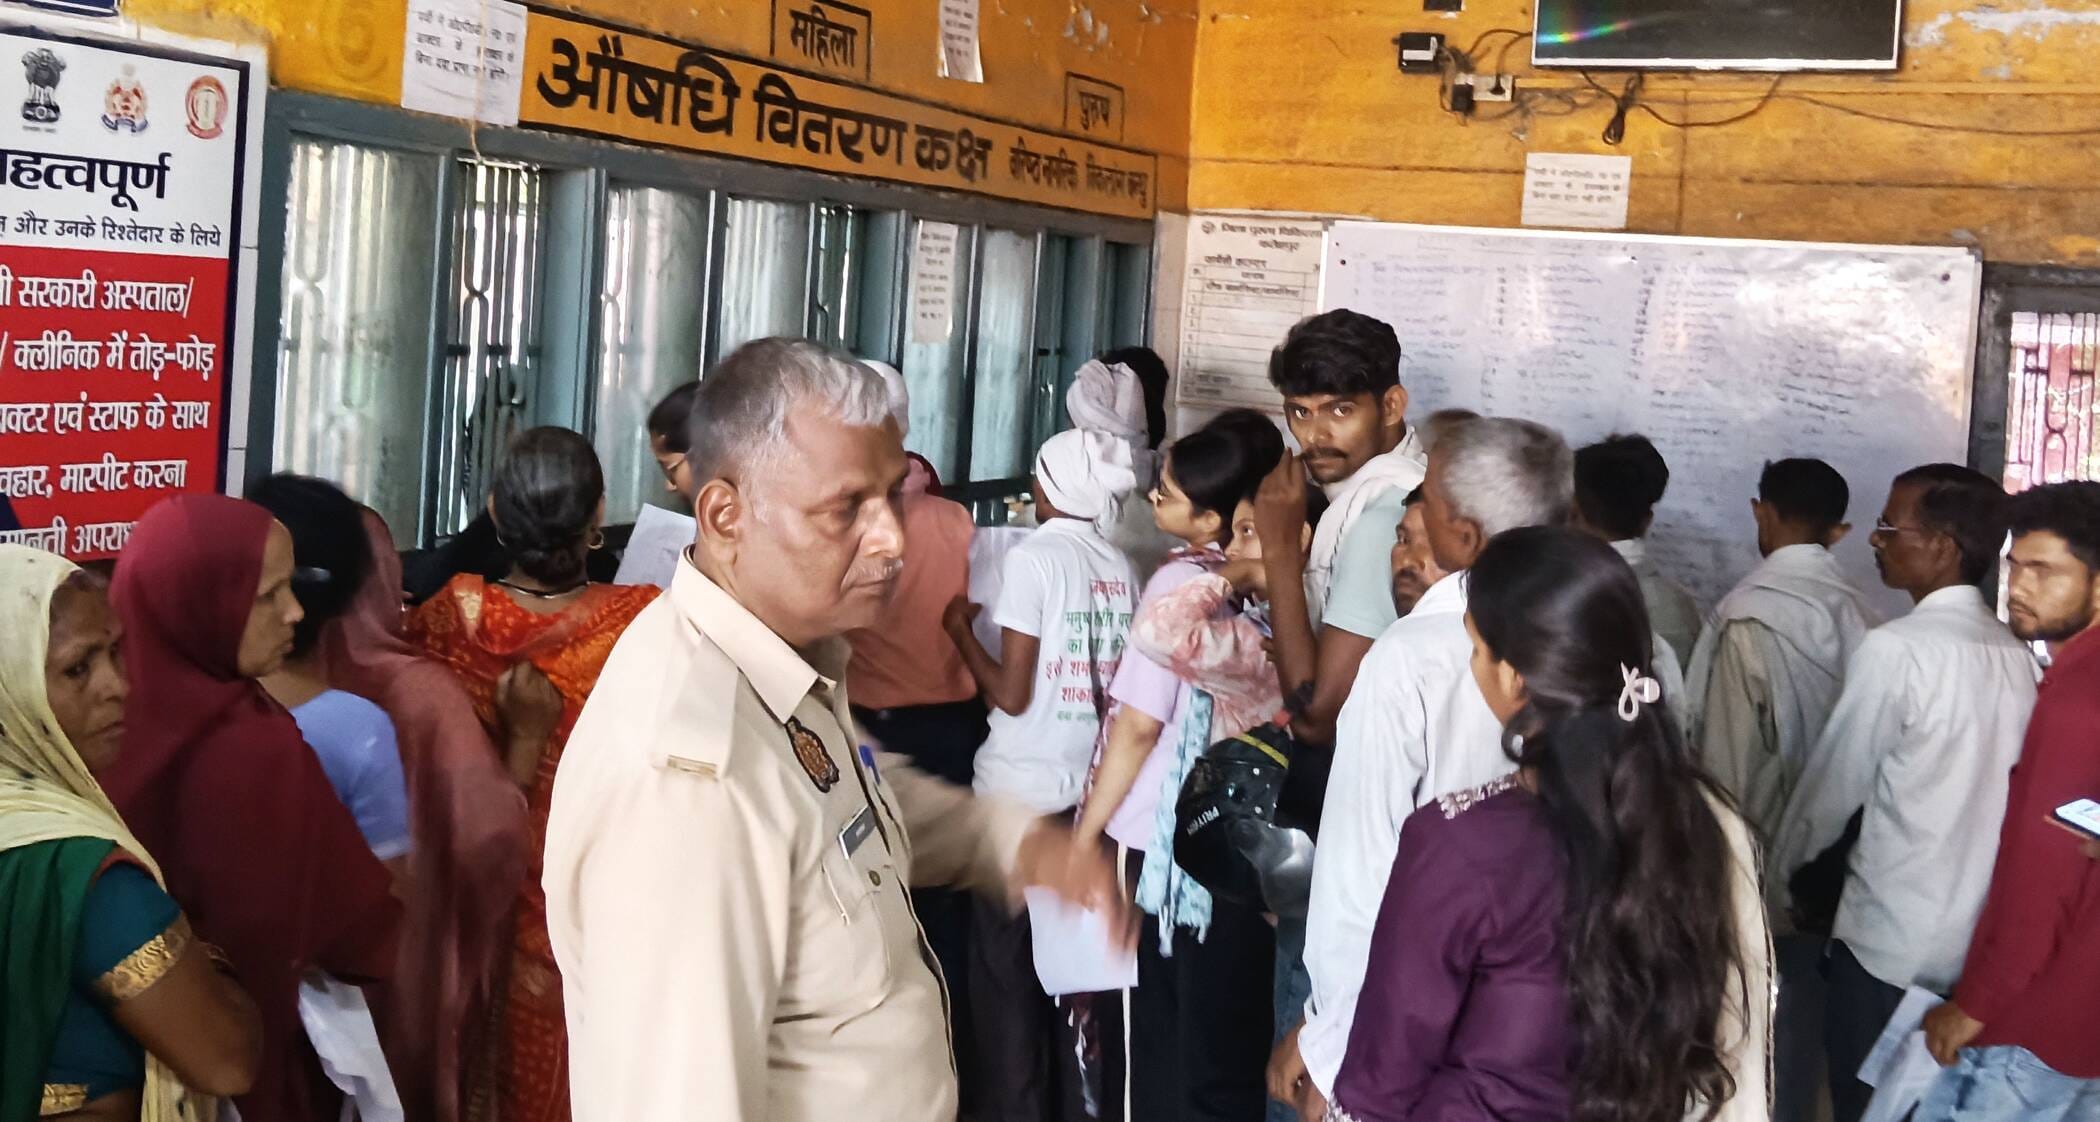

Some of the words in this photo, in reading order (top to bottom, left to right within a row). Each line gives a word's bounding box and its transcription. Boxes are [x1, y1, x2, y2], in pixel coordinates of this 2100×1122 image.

[790, 10, 857, 68] महिला
[537, 36, 741, 137] औषधि
[754, 73, 907, 165] वितरण
[914, 125, 992, 183] कक्ष
[14, 210, 48, 236] और
[54, 215, 96, 239] उनके
[101, 216, 164, 244] रिश्तेदार
[170, 222, 185, 243] के
[191, 223, 221, 247] लिये
[18, 269, 97, 310] सरकारी
[101, 276, 194, 319] अस्पताल/
[14, 329, 103, 371] क्लीनिक
[106, 329, 129, 371] में
[130, 333, 216, 382] तोड़-फोड़
[0, 402, 50, 434] ाक्टर
[54, 391, 87, 435] एवं
[88, 401, 141, 431] स्टाफ
[145, 392, 167, 430] के
[171, 401, 211, 430] साथ
[60, 452, 131, 494] मारपीट
[133, 459, 188, 489] करना
